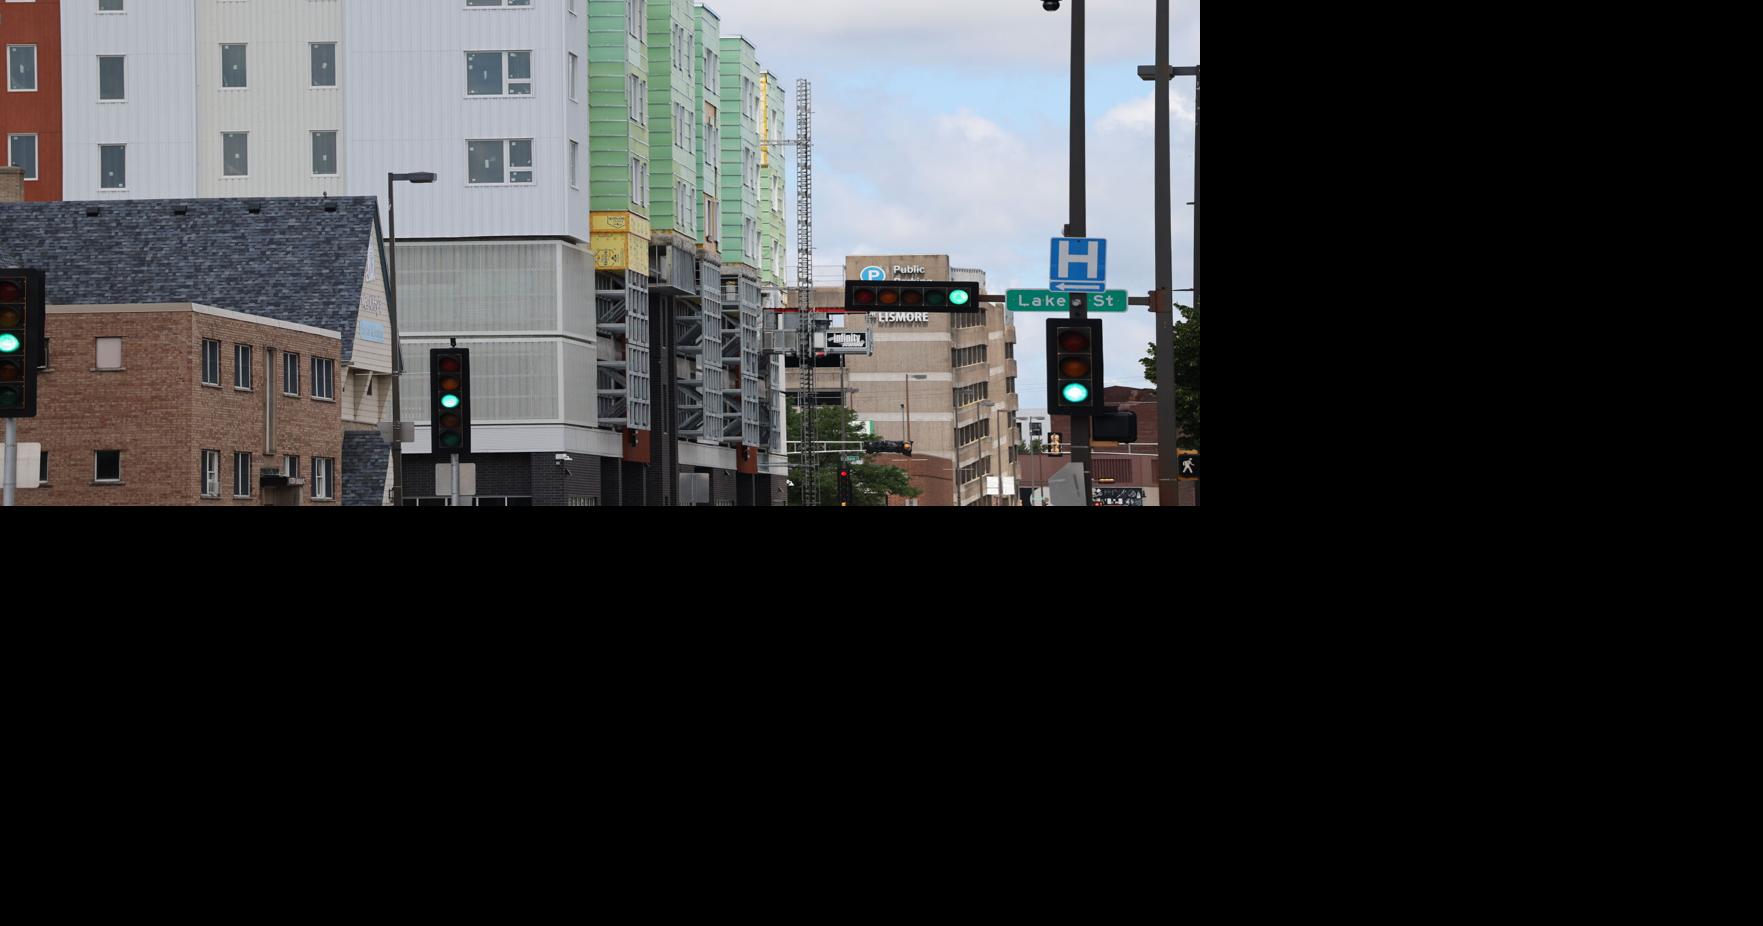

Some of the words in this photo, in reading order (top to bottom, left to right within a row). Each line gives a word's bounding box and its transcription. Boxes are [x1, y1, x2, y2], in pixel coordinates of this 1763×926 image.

[1058, 240, 1098, 279] H
[868, 270, 880, 281] P
[893, 265, 926, 274] Public
[1018, 294, 1066, 307] Lake
[1093, 294, 1114, 307] St
